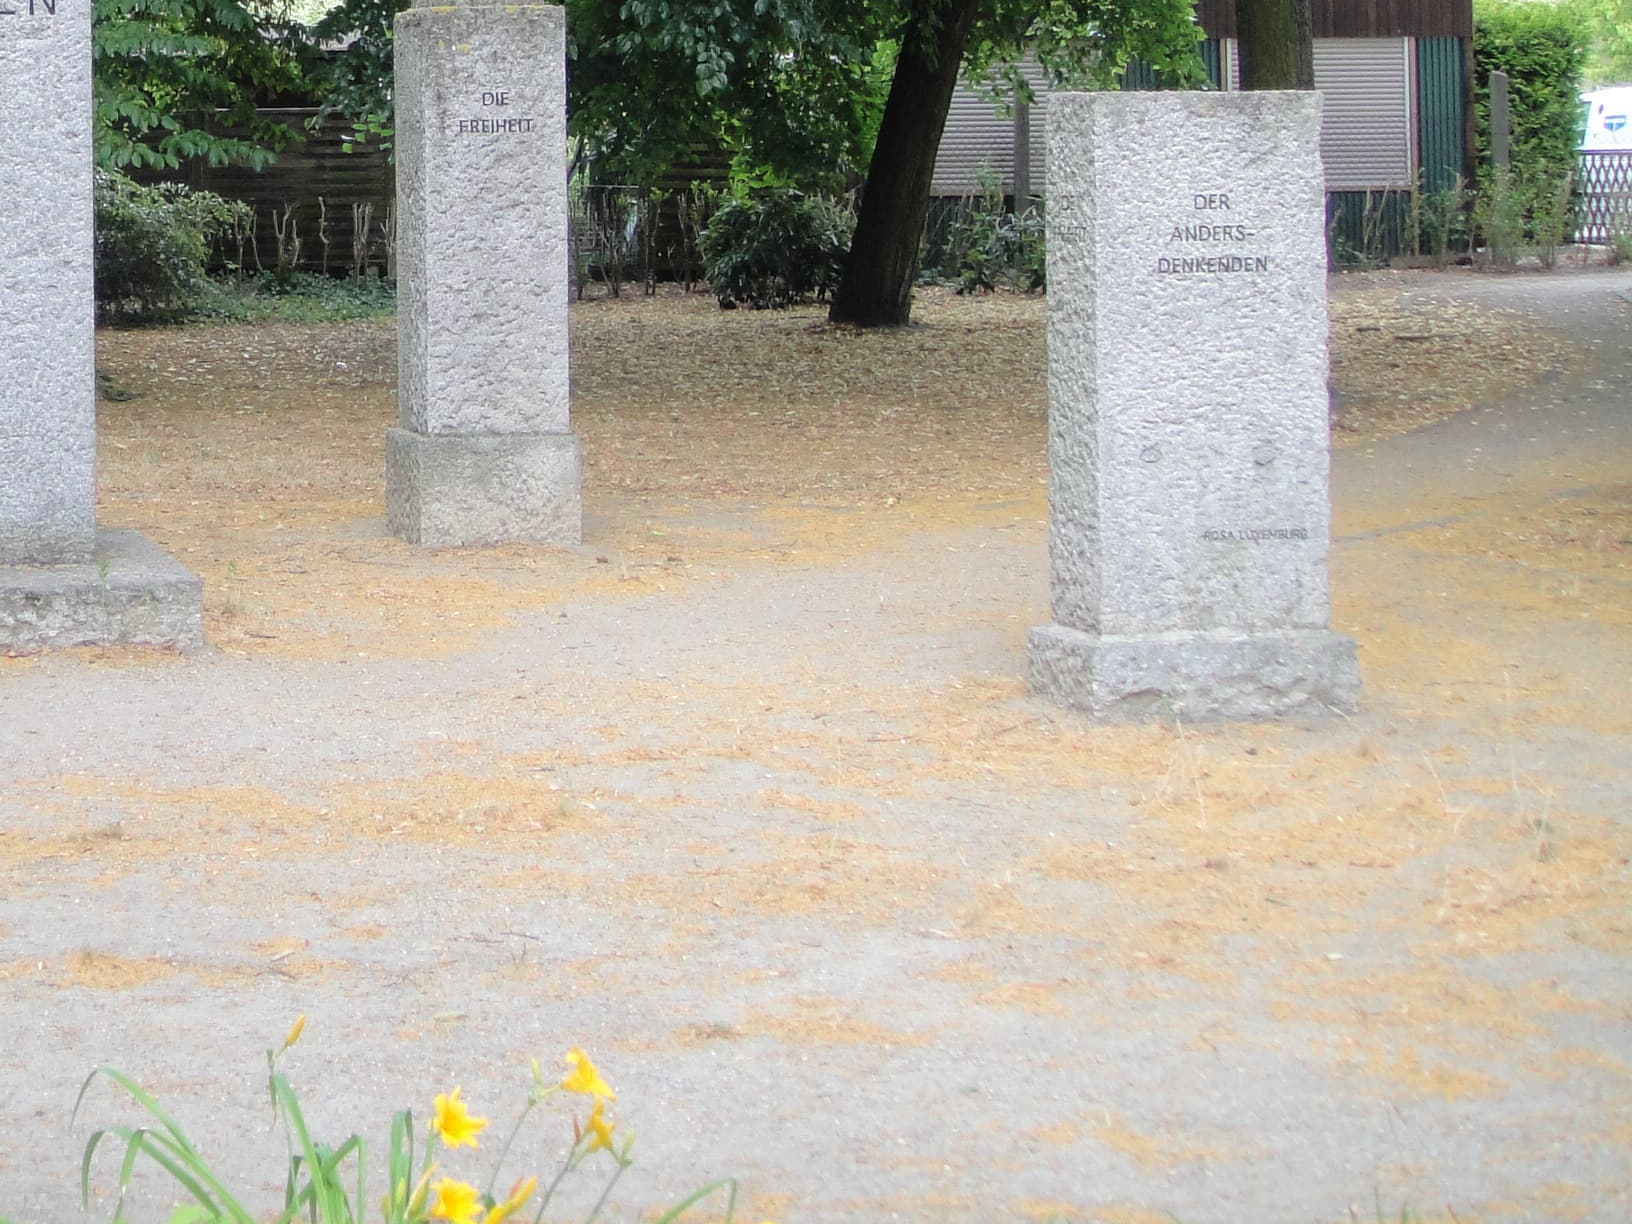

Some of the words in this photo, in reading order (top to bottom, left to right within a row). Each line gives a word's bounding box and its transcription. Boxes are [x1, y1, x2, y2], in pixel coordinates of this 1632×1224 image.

[482, 91, 510, 106] DIE
[459, 118, 534, 133] FREIHEIT
[1193, 194, 1231, 209] DER
[1169, 225, 1256, 242] ANDERS-
[1157, 256, 1268, 274] DENKENDEN
[1202, 530, 1235, 542] ROSA
[1238, 528, 1309, 544] LUXEMBURG
